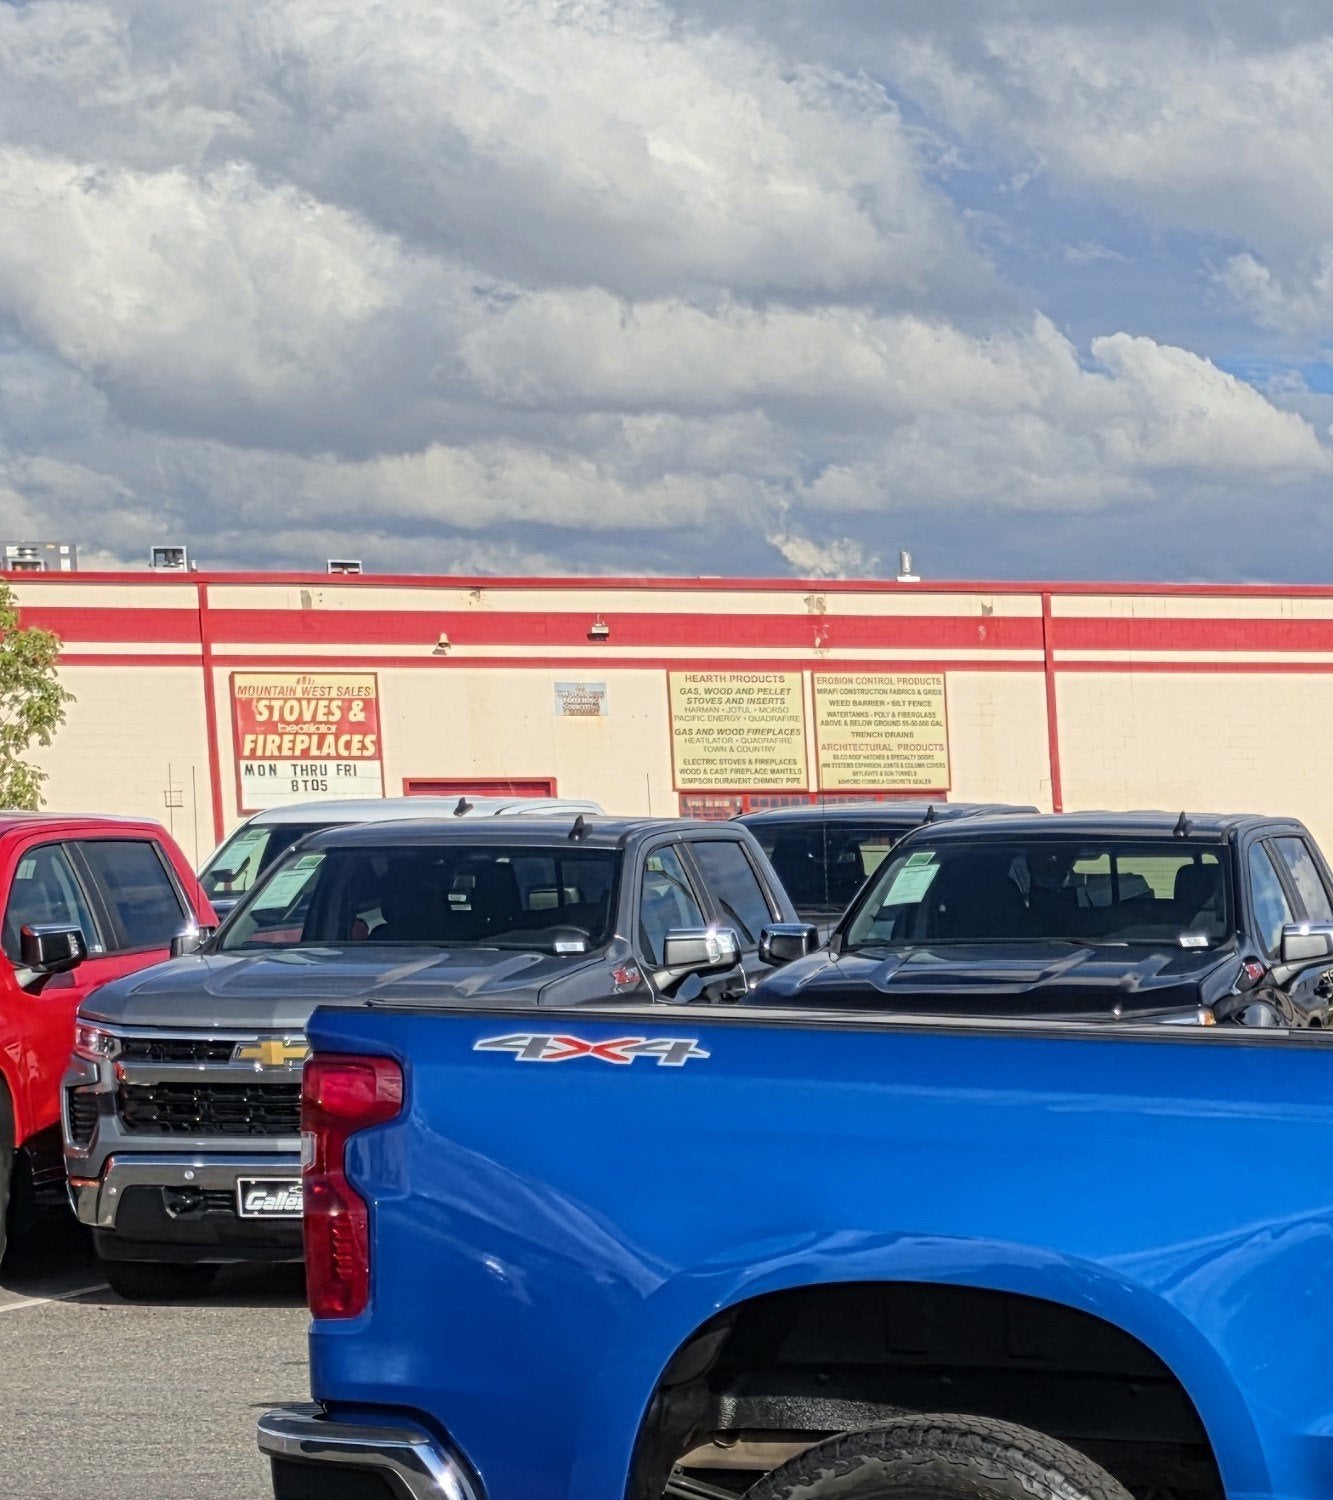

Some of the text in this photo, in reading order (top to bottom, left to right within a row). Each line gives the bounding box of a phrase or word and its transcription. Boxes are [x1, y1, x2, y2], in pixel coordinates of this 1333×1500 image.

[685, 674, 785, 683] HEARTH PRODUCTS
[816, 676, 942, 685] EROSION CONTROL PRODUCTS
[237, 685, 372, 697] MOUNTAIN WEST SALES
[679, 688, 792, 696] GAS, WOOD AND PELLET
[252, 699, 366, 722] STOVES &
[242, 733, 378, 757] FIREPLACES
[244, 763, 357, 777] MON THRU FRI
